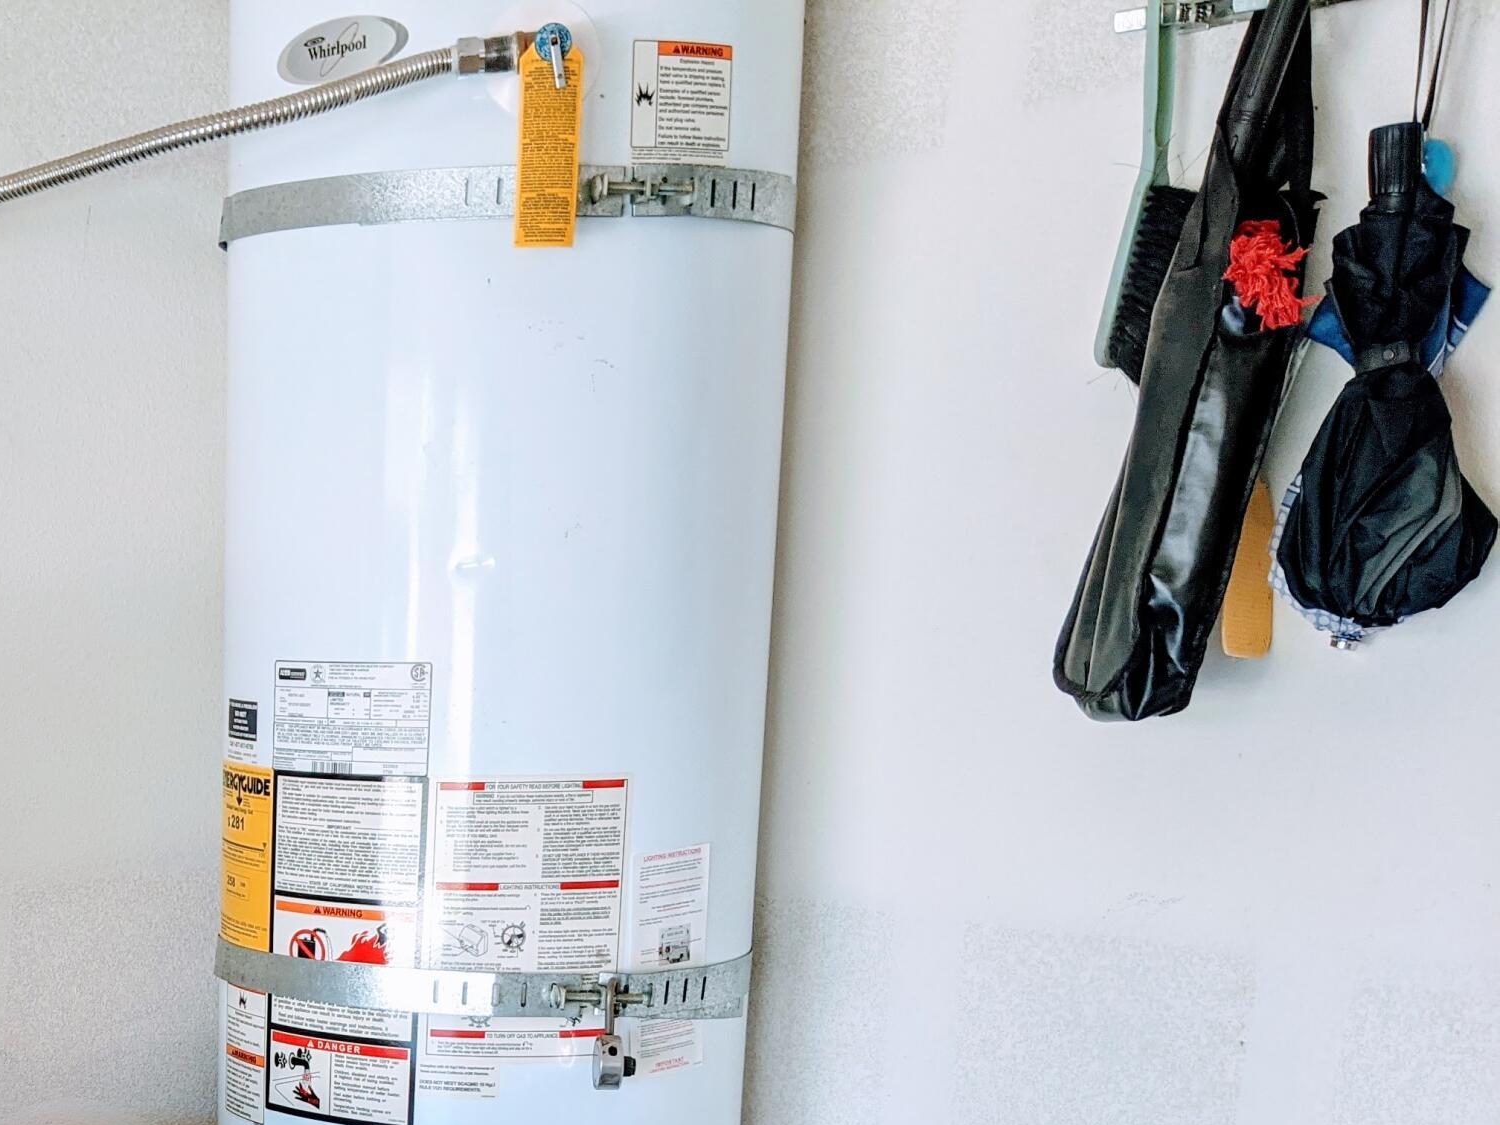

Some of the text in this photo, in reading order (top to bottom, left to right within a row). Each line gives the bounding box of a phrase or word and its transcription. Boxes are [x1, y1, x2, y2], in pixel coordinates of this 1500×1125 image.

[308, 34, 367, 61] Whirlpool
[681, 46, 724, 57] WARNING
[643, 847, 702, 862] LIGHTING INSTRUCTIONS
[322, 906, 363, 918] WARNING
[317, 1040, 361, 1055] DANGER
